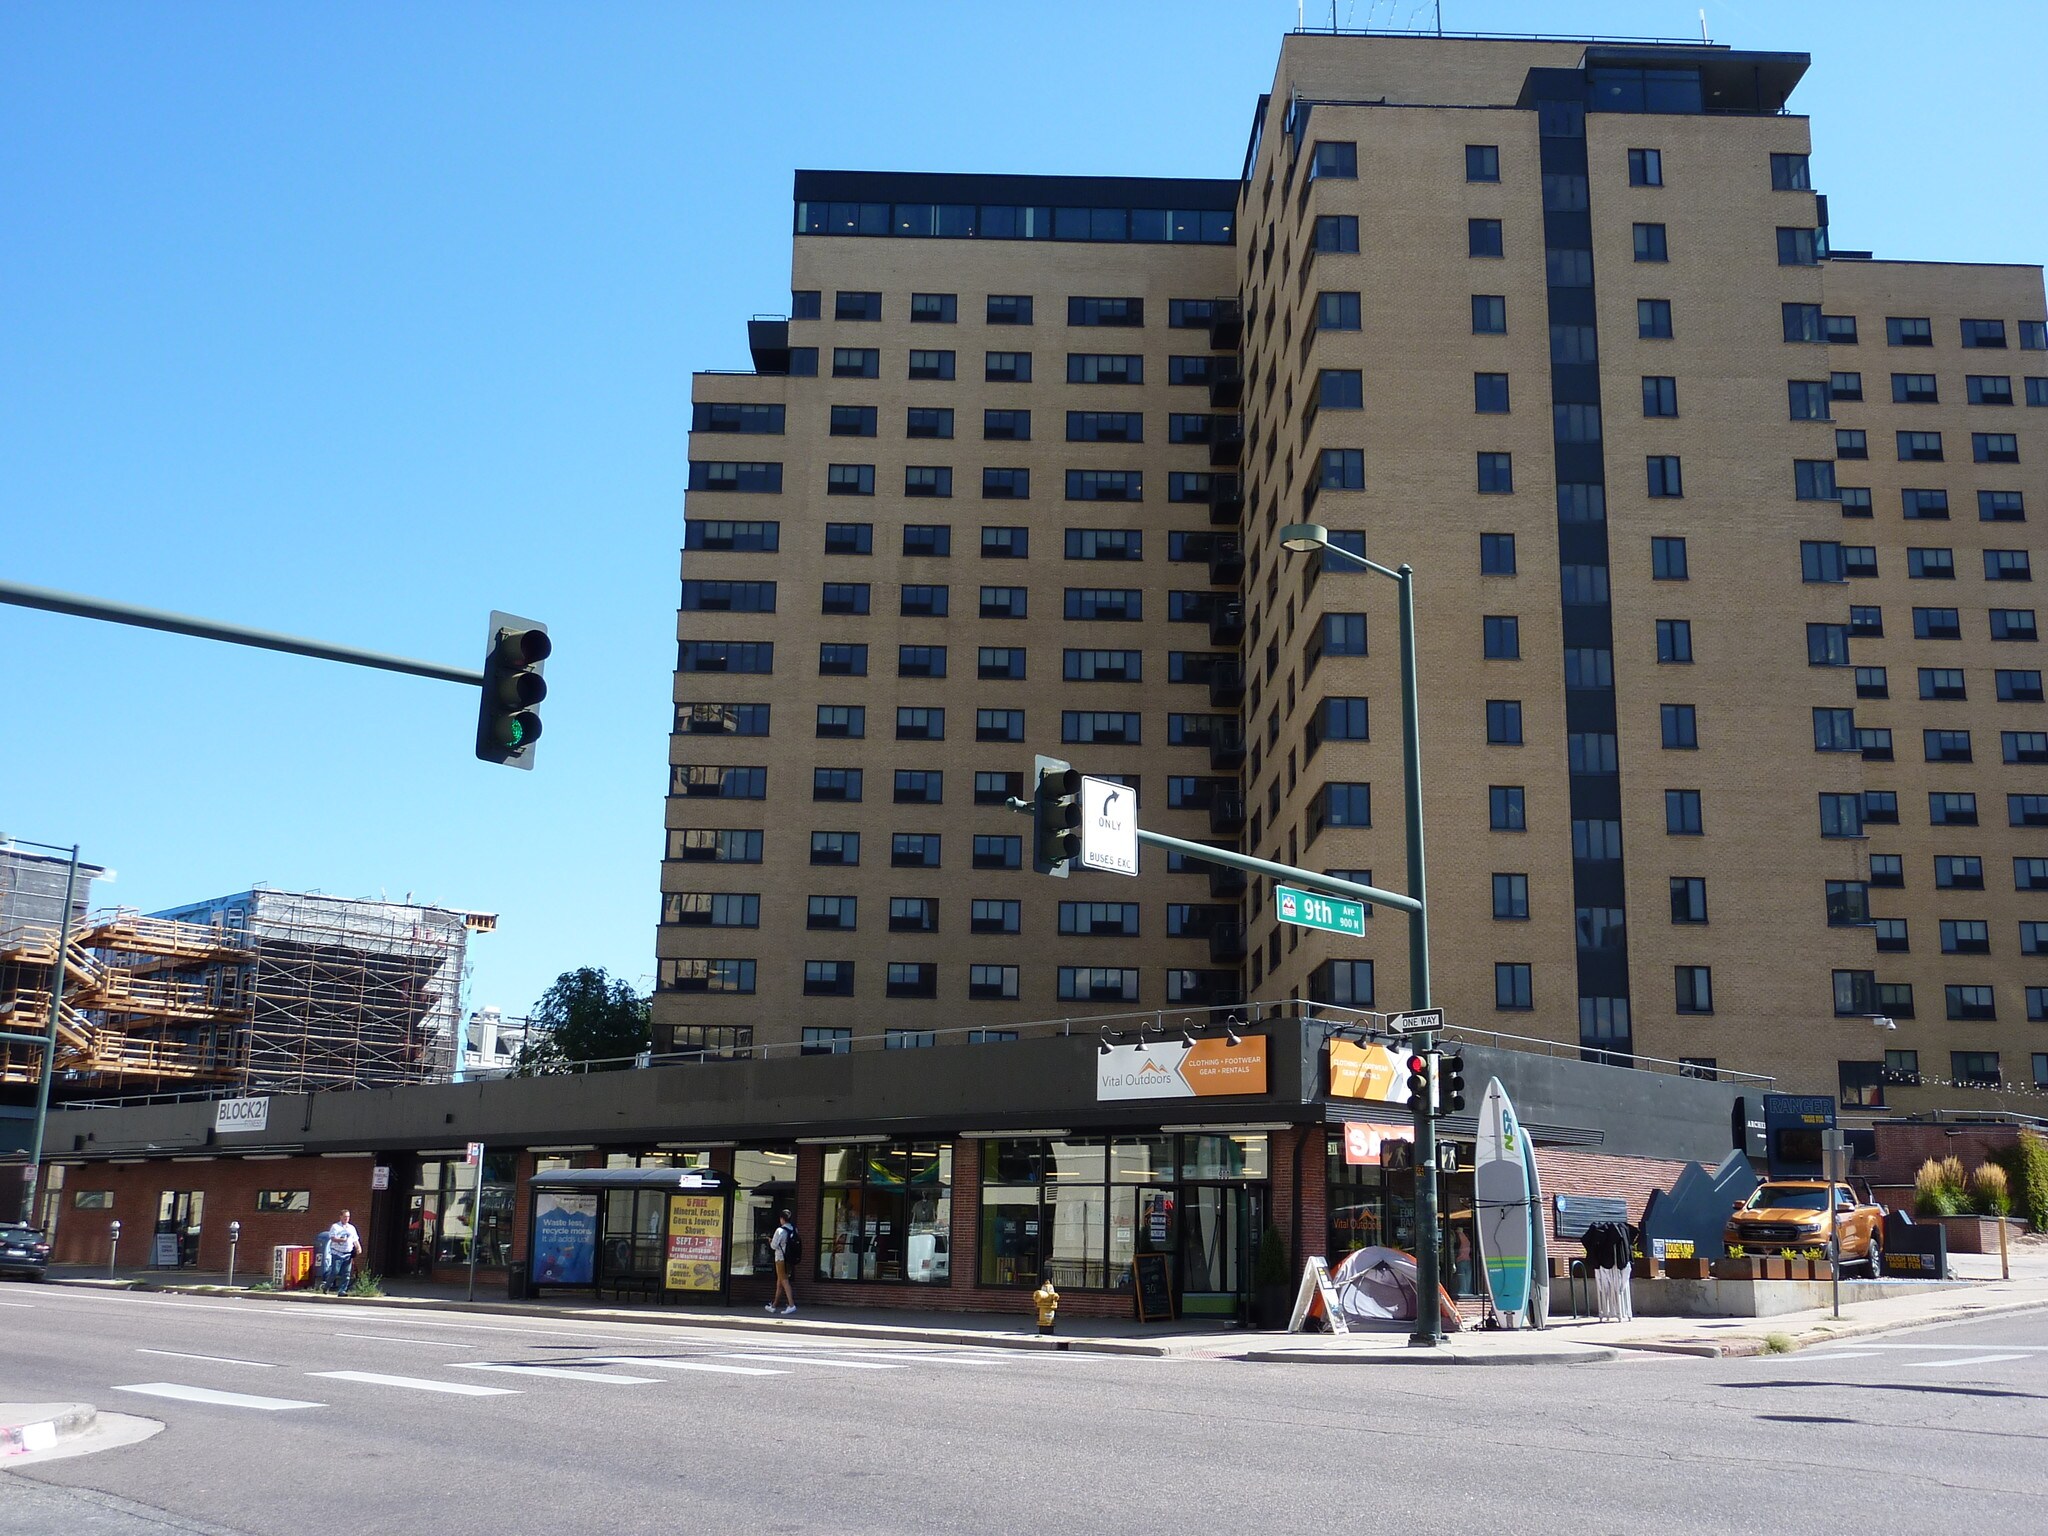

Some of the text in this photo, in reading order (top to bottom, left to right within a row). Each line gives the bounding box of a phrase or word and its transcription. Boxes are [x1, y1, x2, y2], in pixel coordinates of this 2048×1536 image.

[1098, 816, 1121, 831] ONLY
[1089, 851, 1132, 869] BUSES EXC
[1304, 898, 1355, 924] 9th Ave
[1340, 917, 1359, 930] 900 N
[1402, 1015, 1437, 1027] ONE WAY
[1188, 1056, 1261, 1067] CLOTHING FOOTWEAR
[1221, 1066, 1250, 1074] RENTALS
[1102, 1073, 1172, 1087] Vital Outdoors
[219, 1101, 267, 1120] BLOCK21
[1770, 1098, 1832, 1114] RANGER
[1503, 1109, 1514, 1151] NSP
[543, 1219, 585, 1228] Waste less,
[673, 1216, 688, 1225] Gem
[694, 1218, 720, 1227] Jewelry
[1334, 1219, 1349, 1229] Vital
[542, 1228, 569, 1236] recycle
[684, 1226, 706, 1235] Shows
